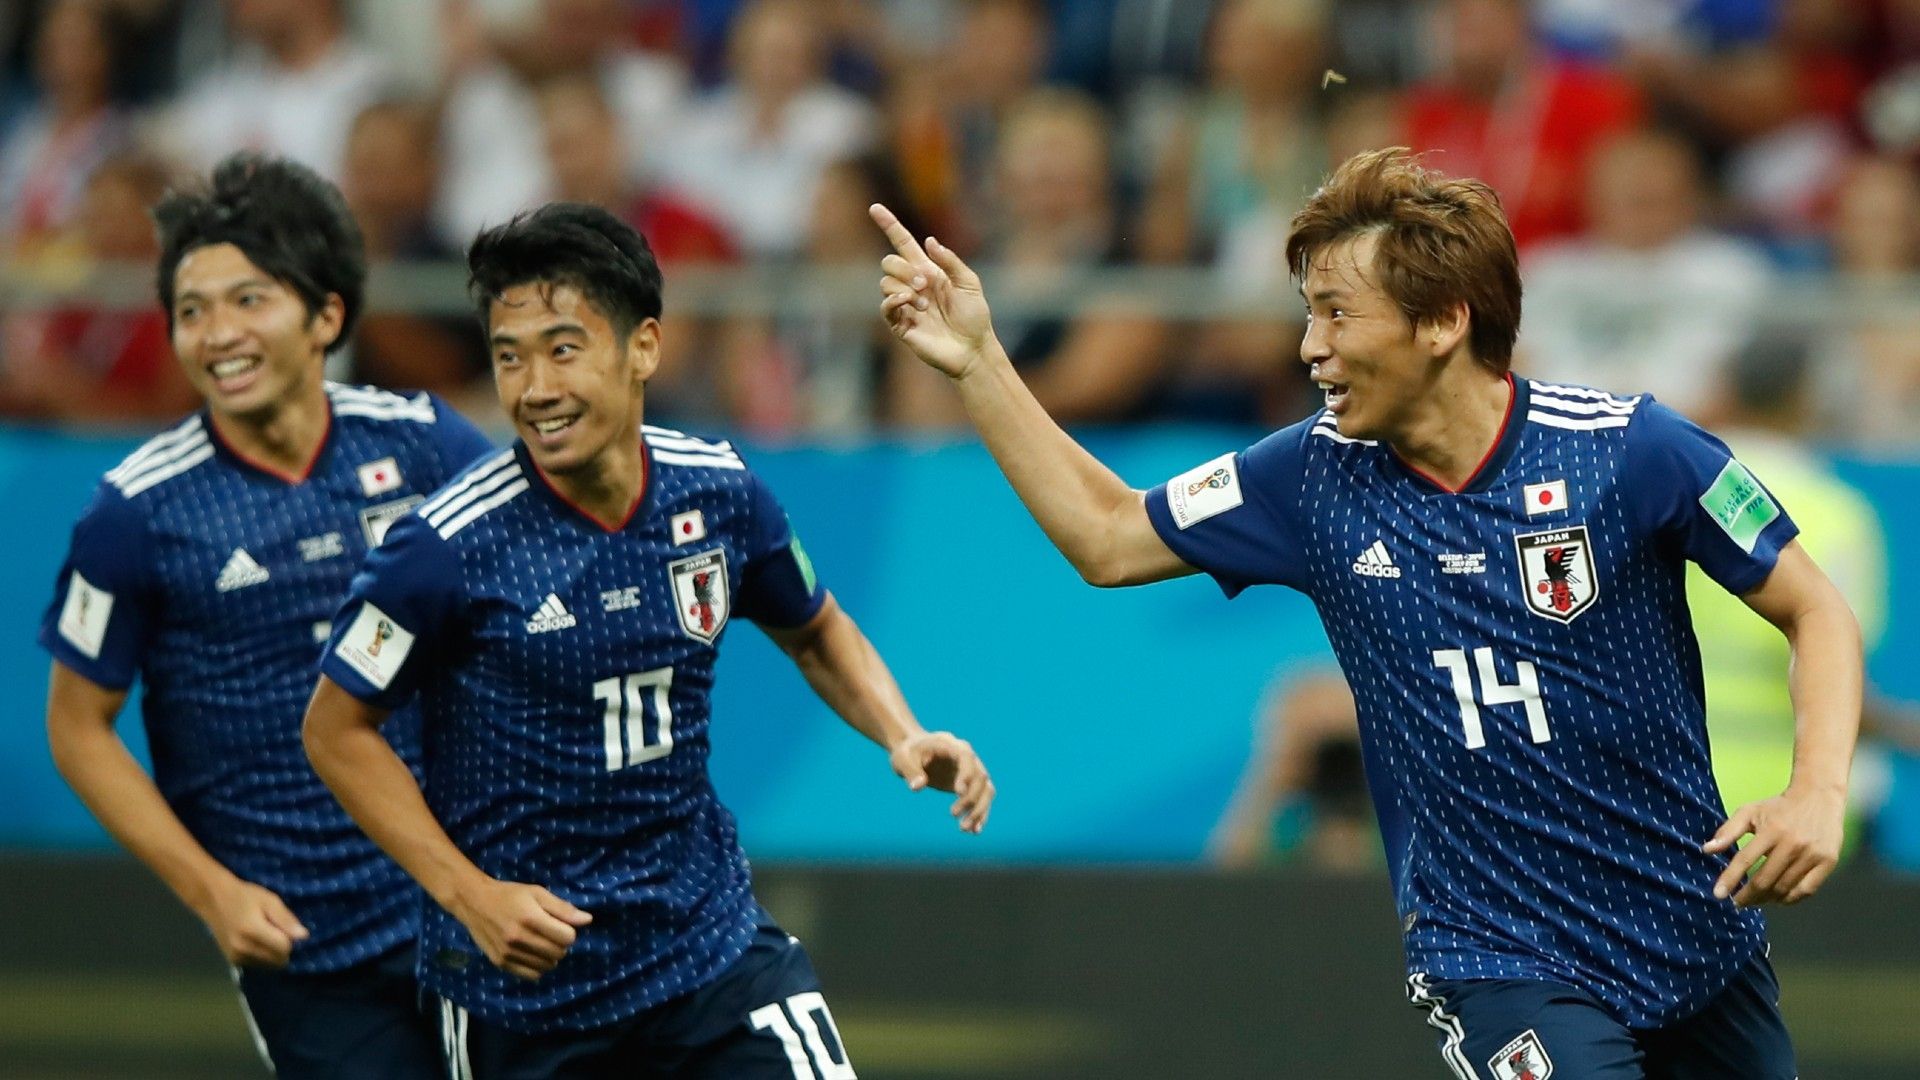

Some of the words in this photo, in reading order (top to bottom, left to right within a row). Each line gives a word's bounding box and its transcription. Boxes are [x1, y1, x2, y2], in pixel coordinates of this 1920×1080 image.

[1746, 496, 1764, 514] FIFA
[1533, 532, 1570, 545] JAPAN
[1353, 562, 1401, 579] adidas
[526, 613, 577, 634] adidas
[1433, 646, 1551, 750] 14
[593, 666, 674, 772] 10
[749, 991, 858, 1080] 10
